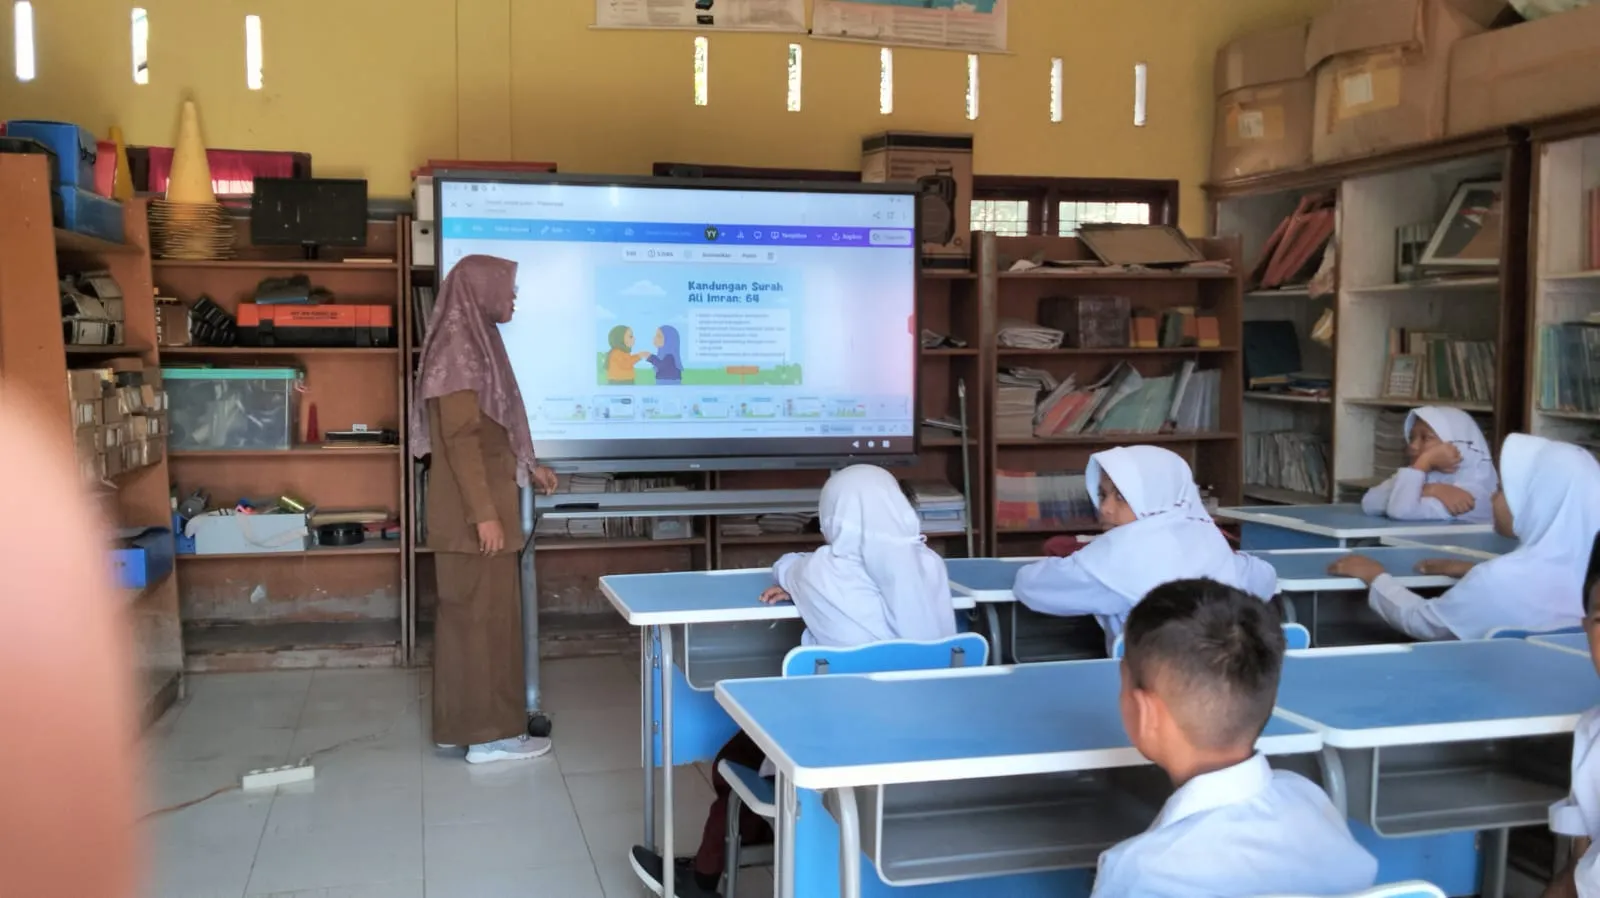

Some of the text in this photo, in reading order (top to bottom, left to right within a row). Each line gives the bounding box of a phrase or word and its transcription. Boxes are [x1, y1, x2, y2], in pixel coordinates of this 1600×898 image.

[688, 281, 784, 292] Kandungan Surah
[688, 293, 760, 303] Ali Imran: 64
